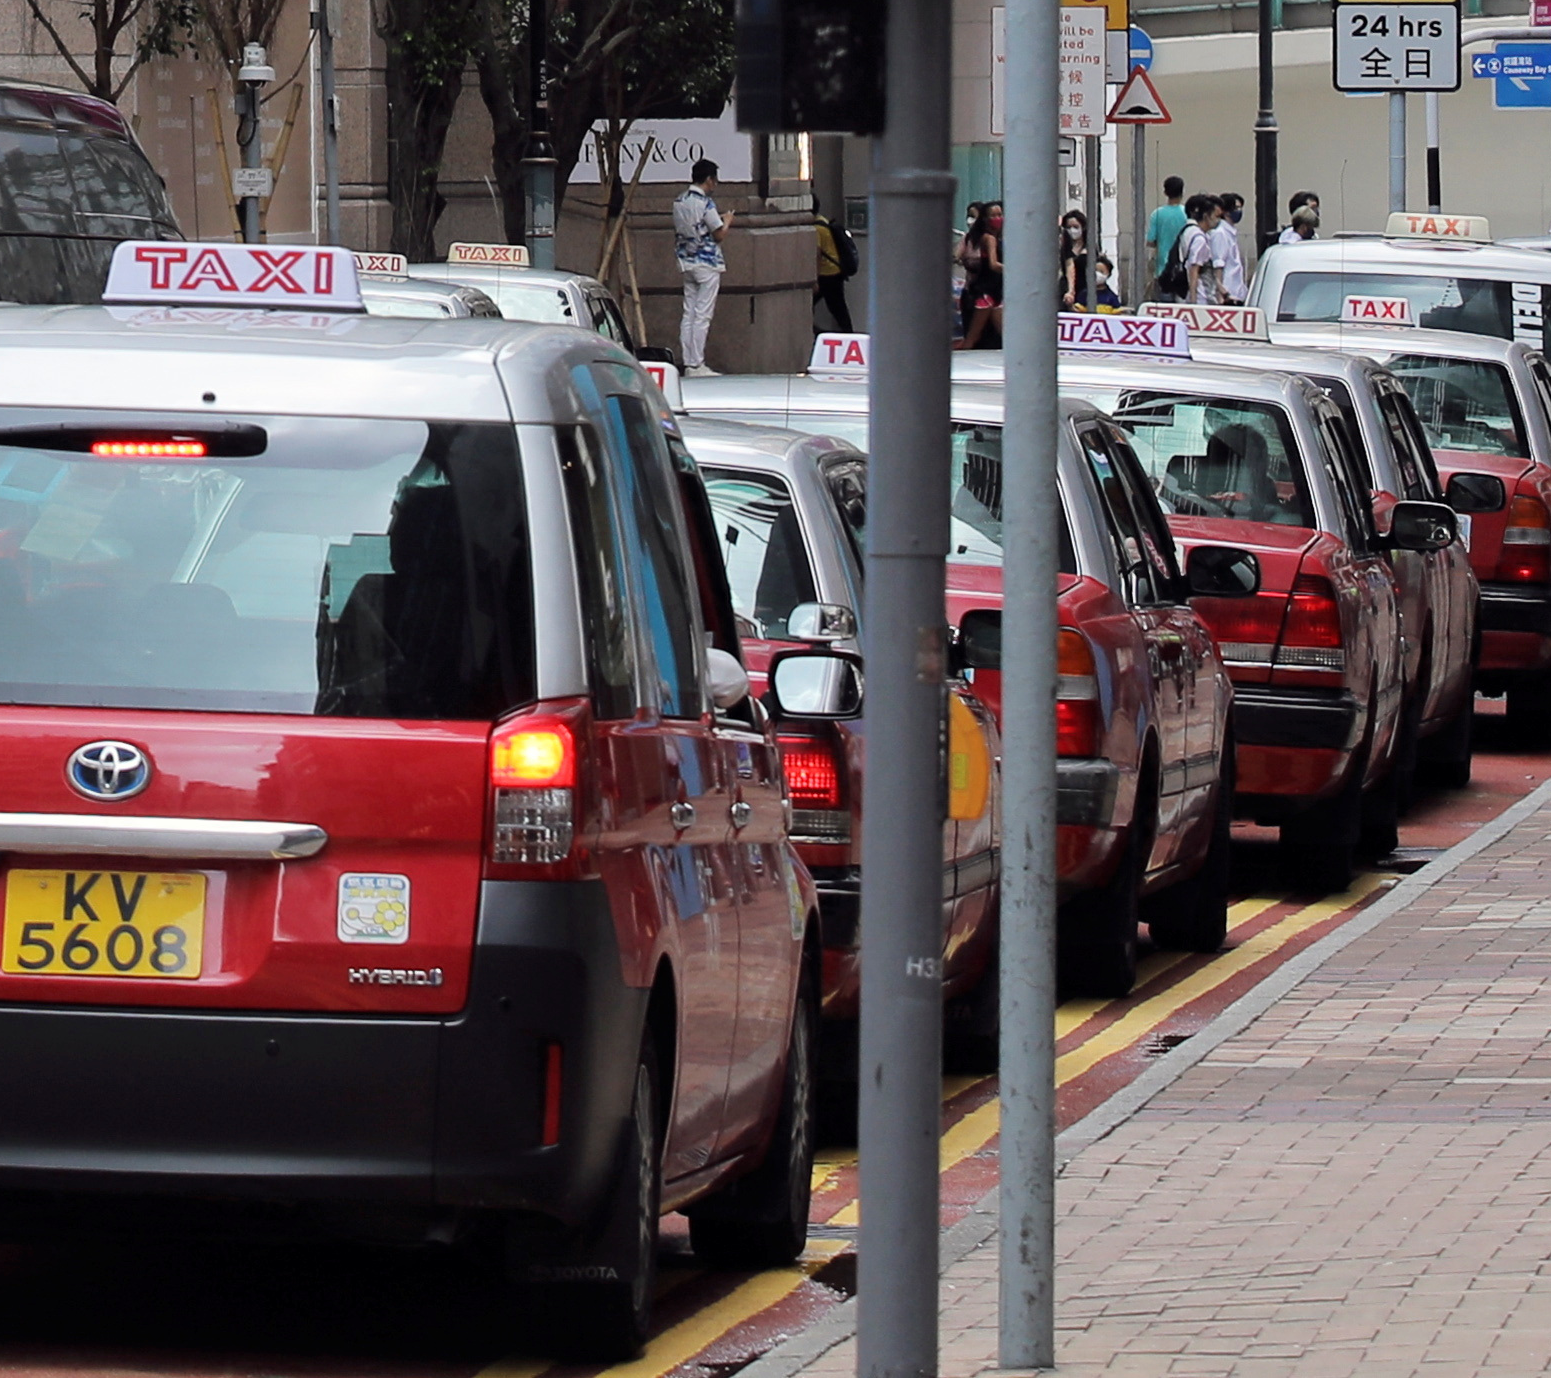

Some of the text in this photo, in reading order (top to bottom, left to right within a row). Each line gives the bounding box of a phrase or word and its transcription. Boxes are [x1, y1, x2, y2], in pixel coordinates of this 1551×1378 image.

[1079, 26, 1095, 36] be
[1350, 13, 1443, 38] 24 hrs
[1060, 54, 1101, 65] arning
[1359, 46, 1432, 79] 全日
[1406, 216, 1470, 237] TAXI
[354, 255, 401, 272] AXI
[455, 245, 523, 262] TAXI
[135, 246, 334, 295] TAXI
[1349, 298, 1406, 320] TAXI
[1060, 317, 1177, 348] TAXI
[63, 871, 147, 923] KV
[16, 921, 190, 974] 5608
[347, 967, 430, 985] HYBRID
